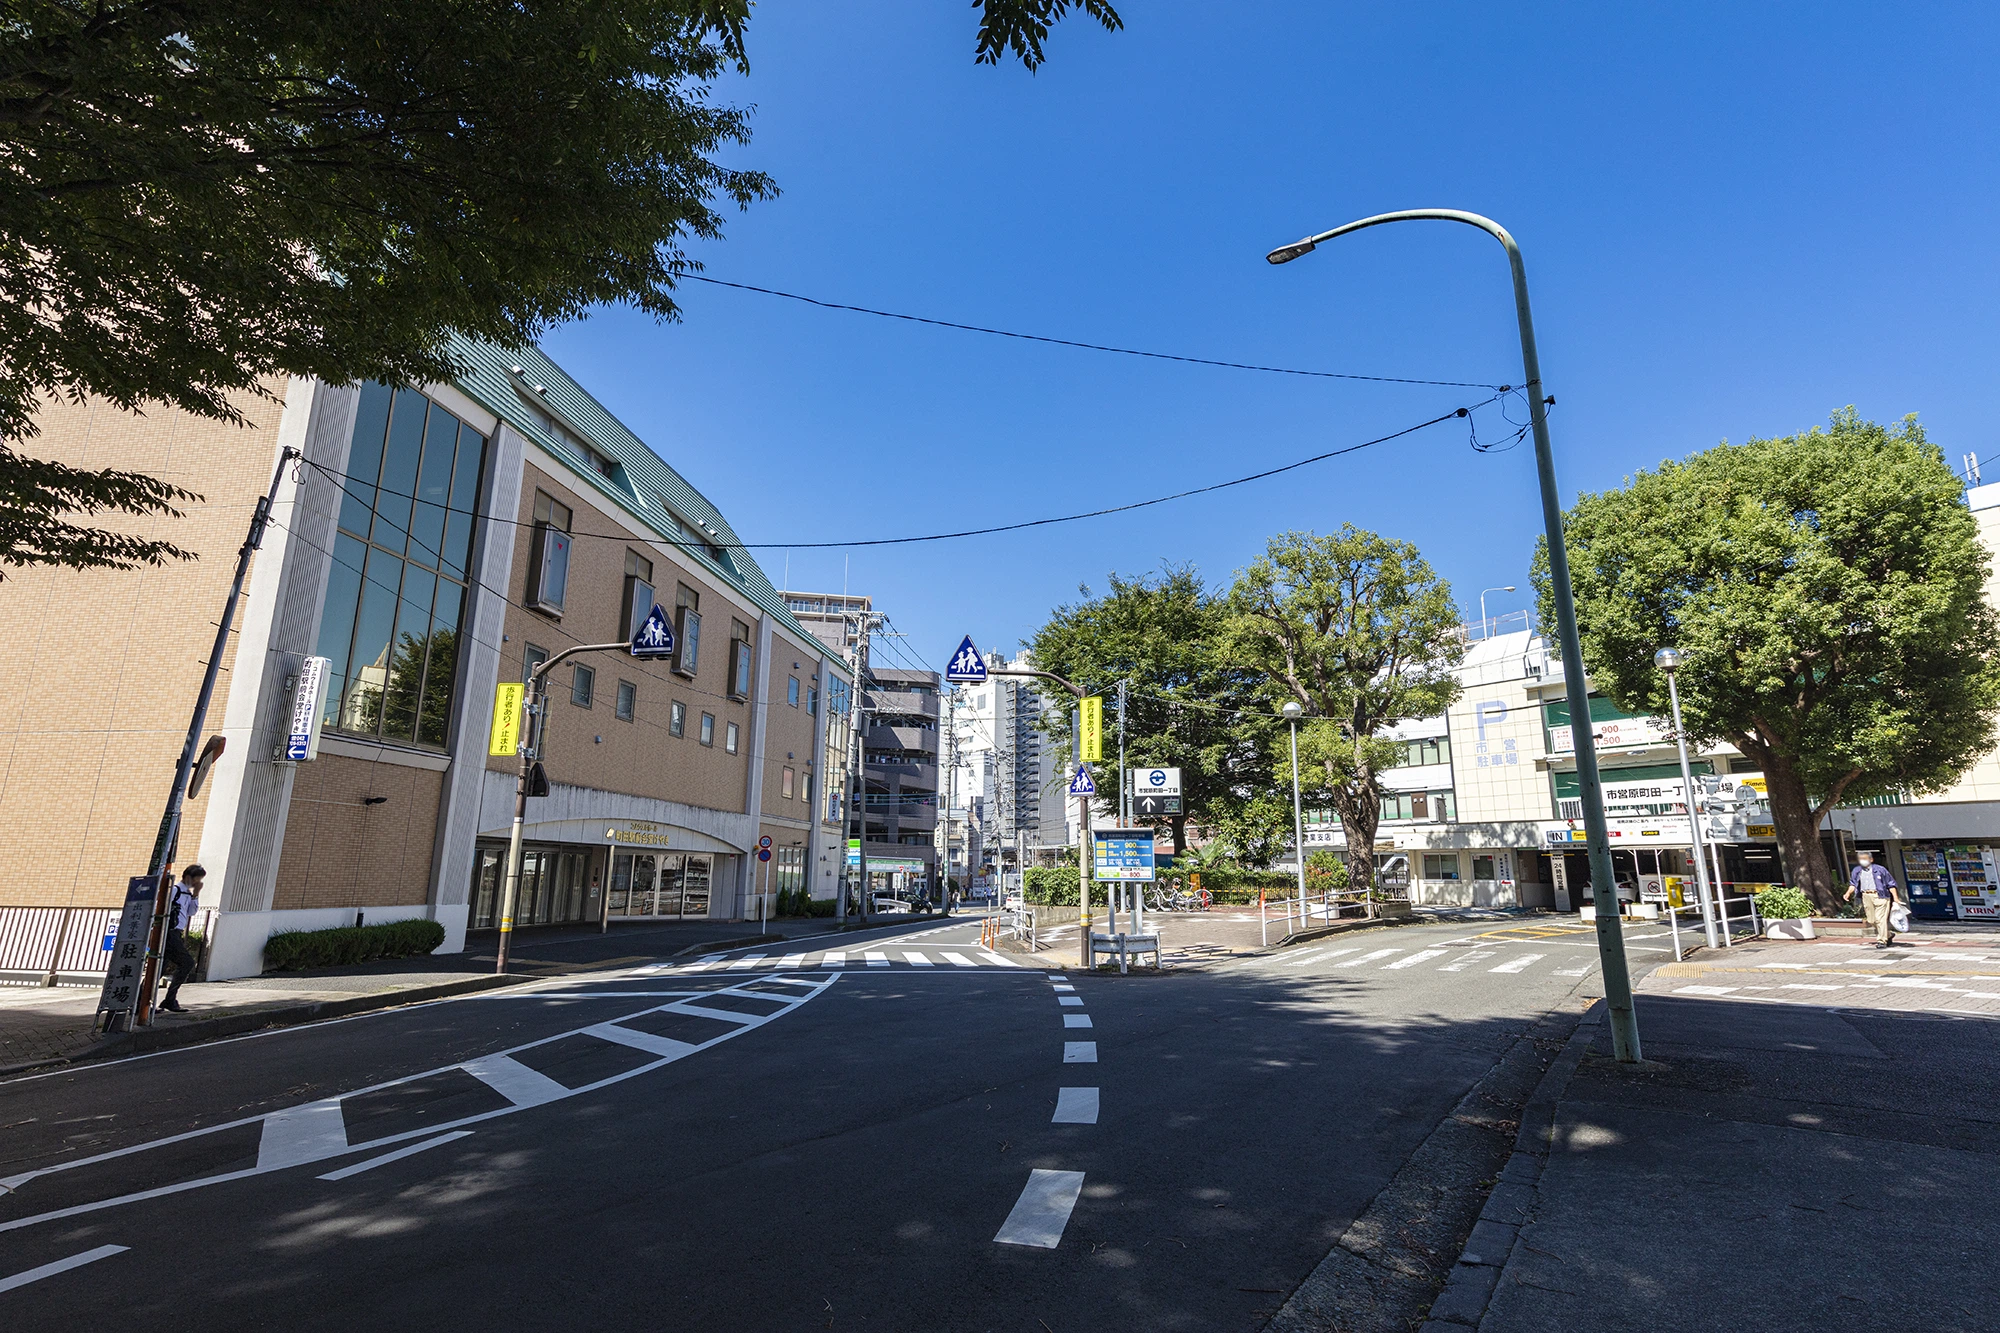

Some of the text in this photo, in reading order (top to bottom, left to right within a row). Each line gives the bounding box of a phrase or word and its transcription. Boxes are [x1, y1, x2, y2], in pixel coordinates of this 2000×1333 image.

[1476, 700, 1508, 741] P
[1601, 725, 1619, 734] 900
[1477, 753, 1518, 767] 駐車場
[1750, 826, 1768, 835] 出口
[1552, 832, 1563, 841] IN
[762, 838, 771, 846] 30
[111, 944, 138, 1003] 駐車場
